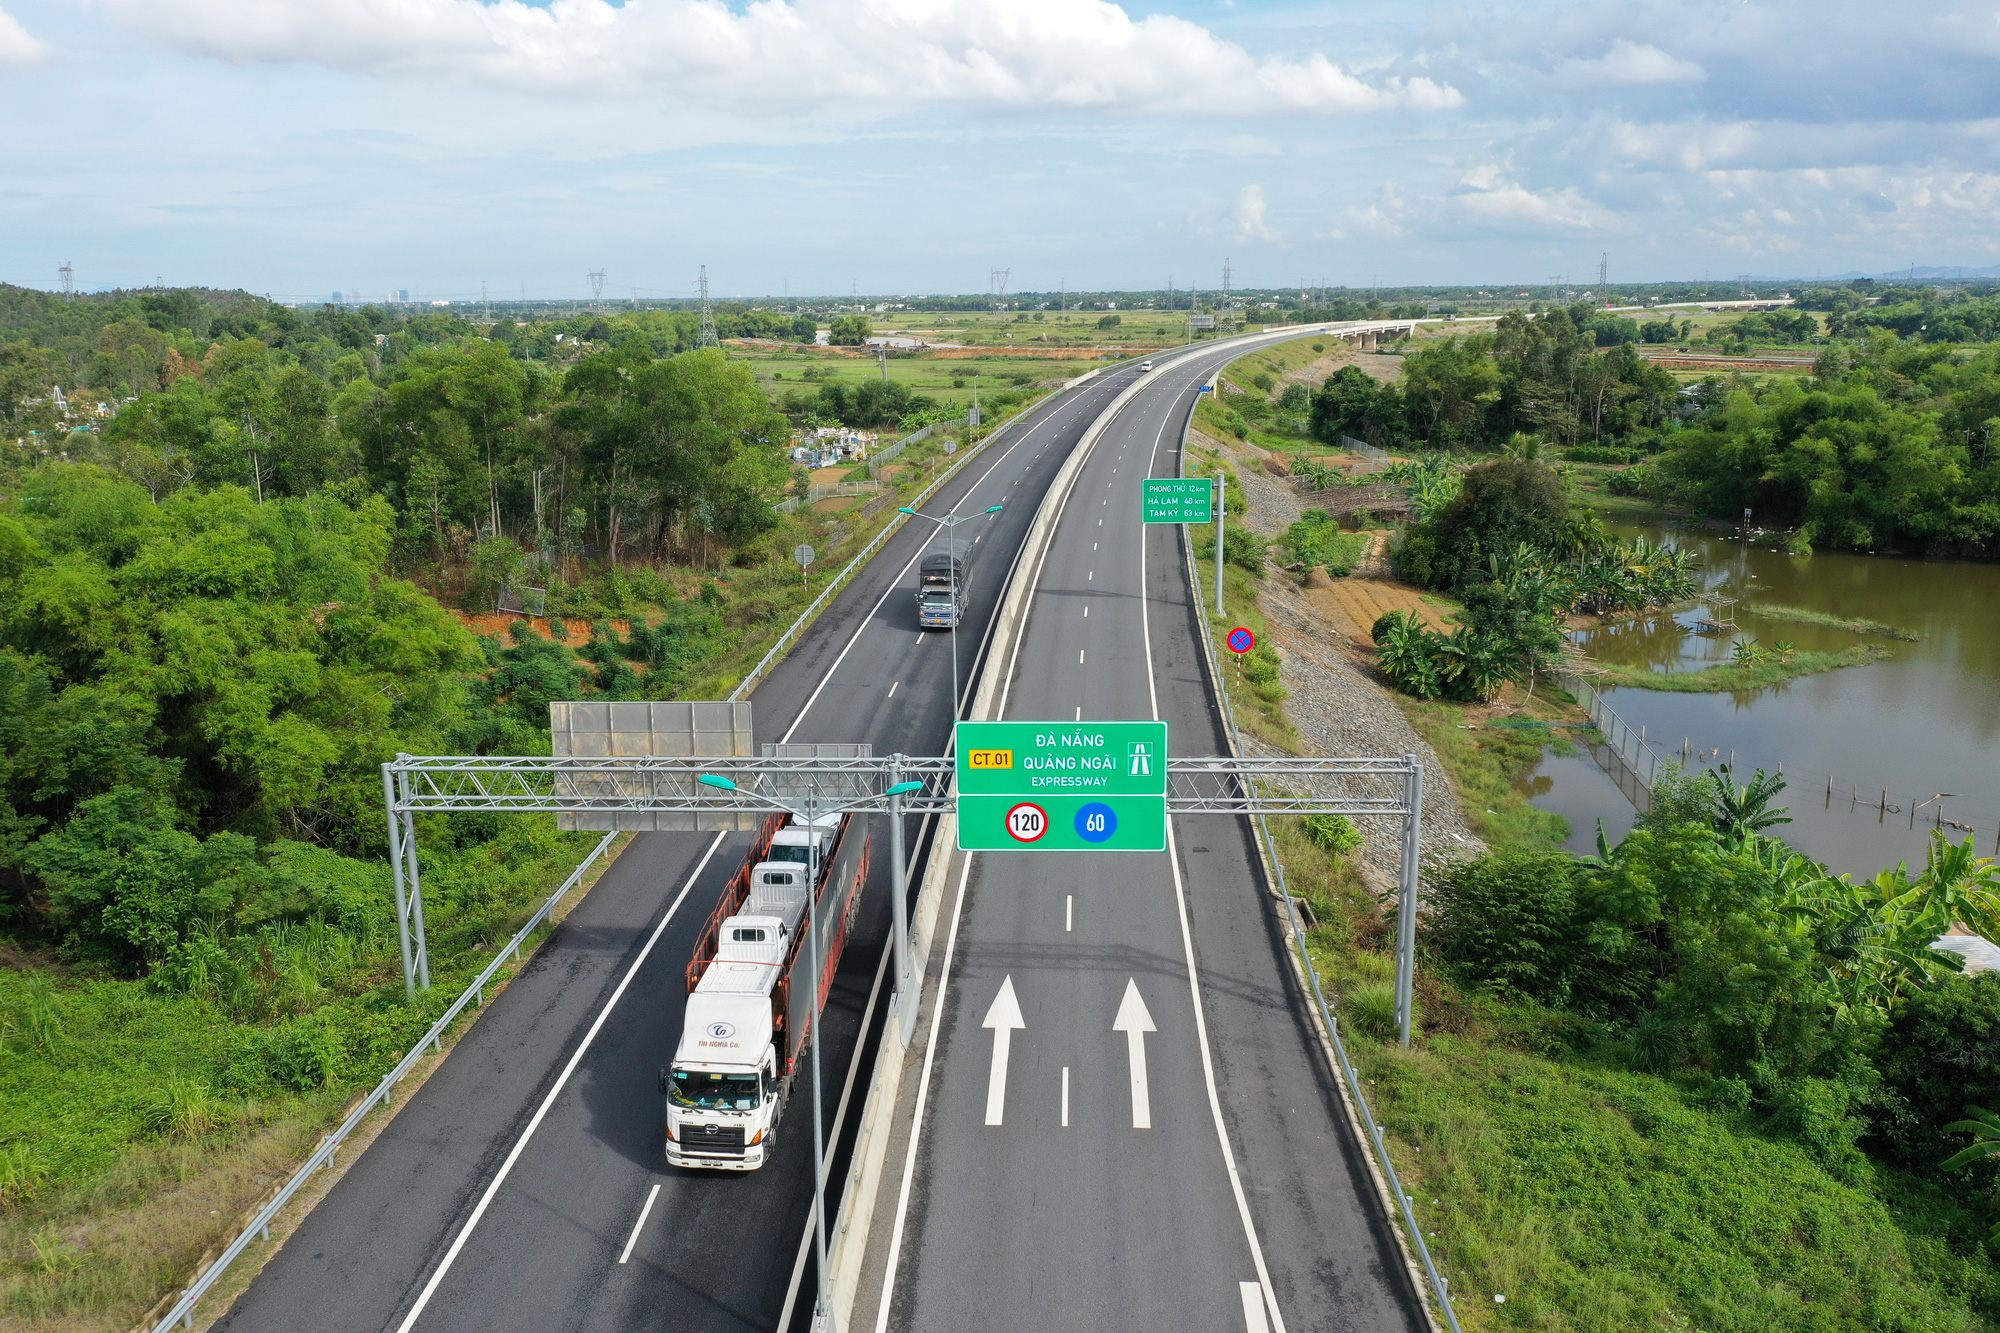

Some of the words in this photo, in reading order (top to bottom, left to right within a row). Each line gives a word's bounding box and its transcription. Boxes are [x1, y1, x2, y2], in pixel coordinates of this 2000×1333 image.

[1035, 731, 1057, 747] ĐÀ
[1061, 728, 1104, 747] NẴNG
[973, 753, 1008, 765] CT.01
[1023, 753, 1076, 770] QUẢNG
[1081, 754, 1116, 769] NGÃI
[1031, 776, 1108, 787] EXPRESSWAY
[1012, 813, 1039, 831] 120
[1086, 813, 1105, 831] 60
